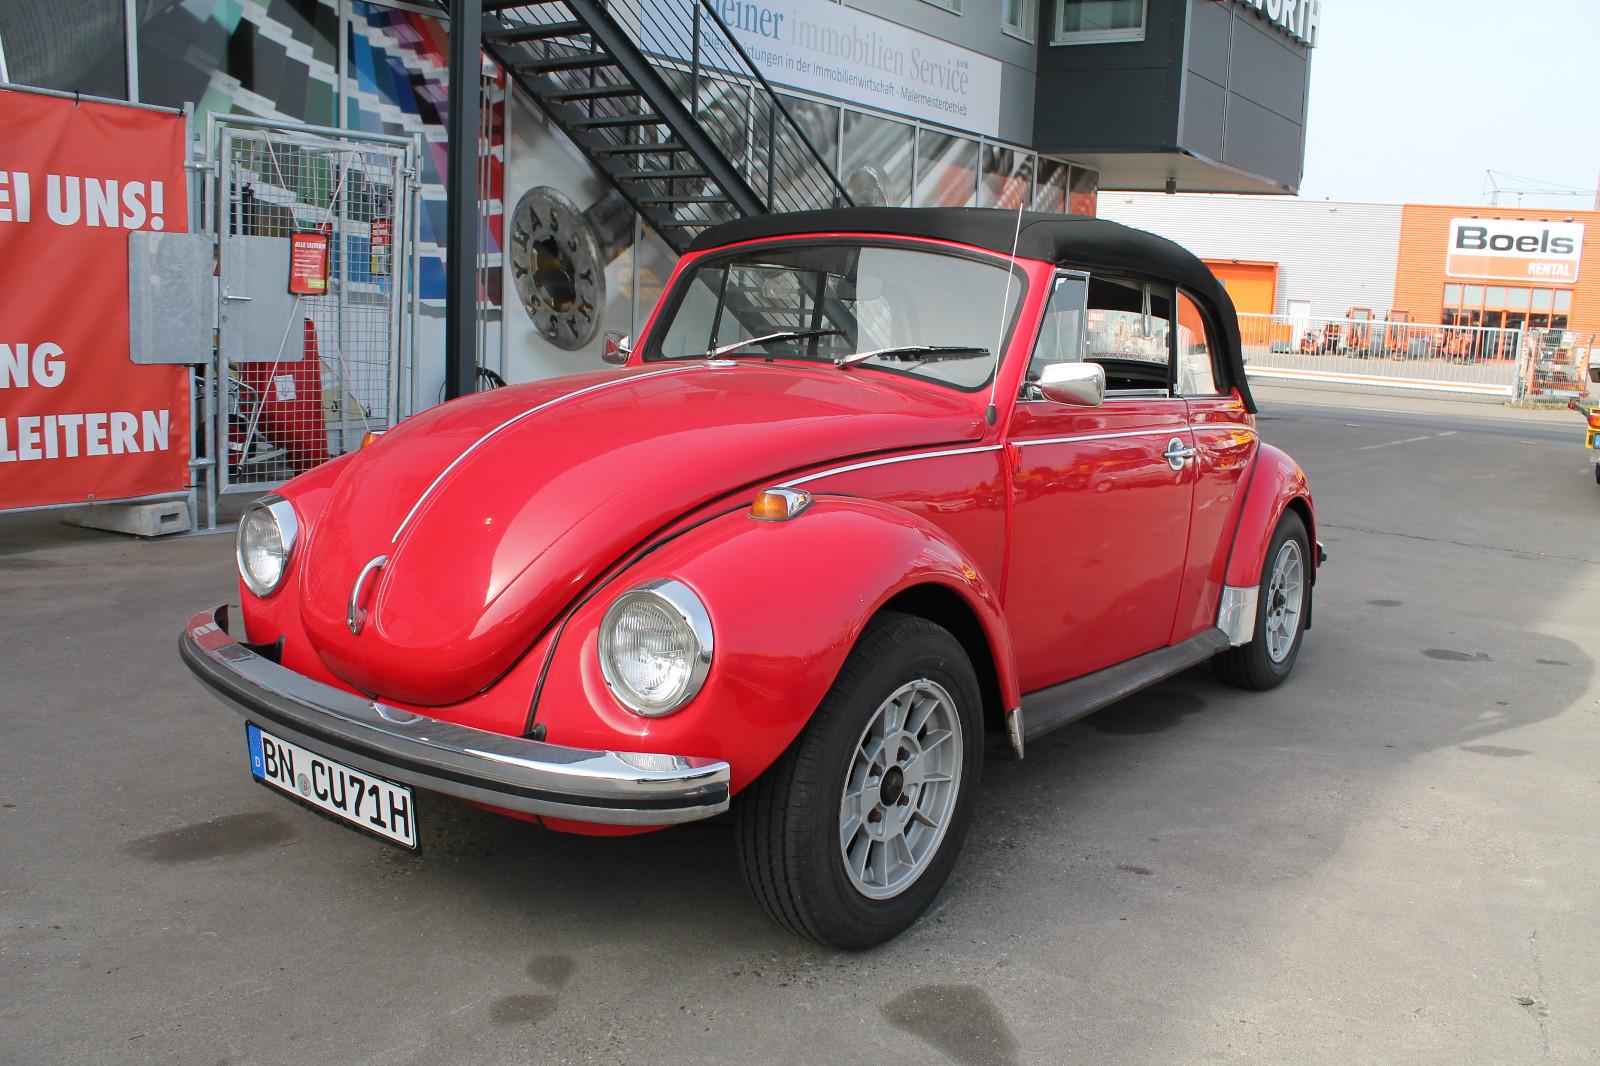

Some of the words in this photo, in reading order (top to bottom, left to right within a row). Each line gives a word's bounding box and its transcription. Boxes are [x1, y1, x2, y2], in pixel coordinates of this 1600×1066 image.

[1240, 0, 1320, 48] RTH
[703, 31, 783, 67] Dienstistungen
[785, 54, 794, 70] in
[796, 57, 811, 74] der
[813, 61, 895, 97] Immobilienwirtschaft
[900, 86, 968, 117] Malermeisterbetrieb
[791, 9, 904, 76] immobilien
[910, 47, 968, 96] Service
[47, 174, 164, 231] UNS!
[1456, 225, 1574, 255] Boels
[1527, 262, 1571, 277] RENTAL
[0, 410, 170, 463] LEITERN
[254, 755, 261, 768] D
[262, 736, 296, 788] BN
[311, 759, 410, 839] CU71H
